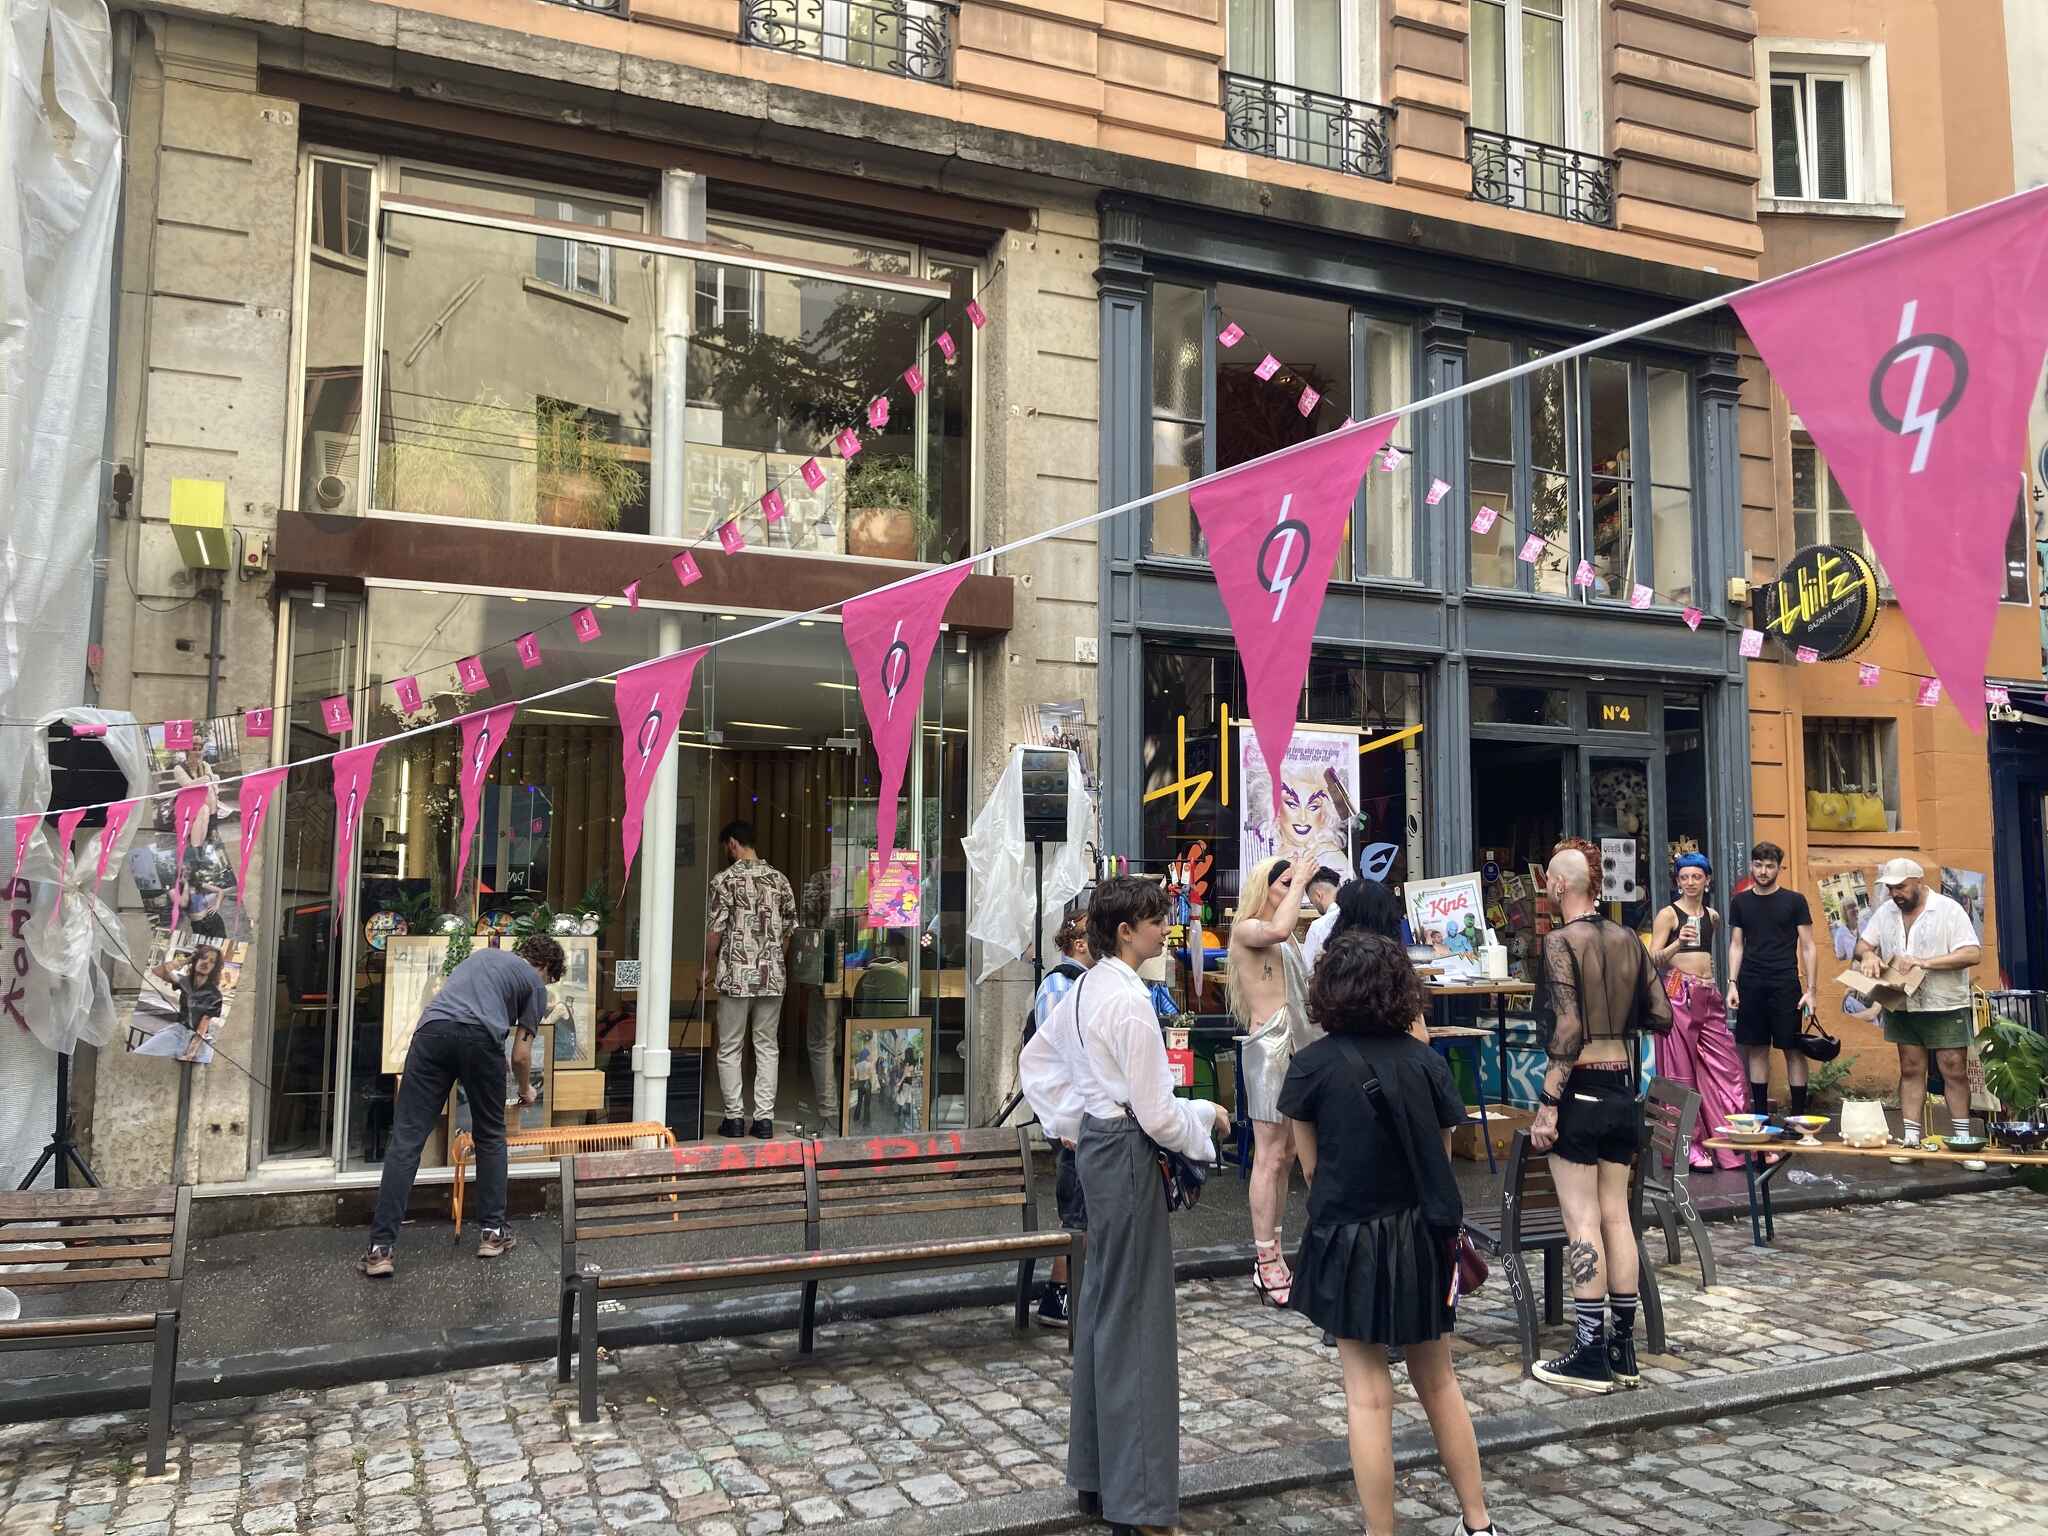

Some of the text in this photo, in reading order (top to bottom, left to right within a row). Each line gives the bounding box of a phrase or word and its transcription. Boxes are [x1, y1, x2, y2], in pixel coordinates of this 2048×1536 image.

[1807, 613, 1827, 632] BAZAR
[1832, 593, 1857, 615] GALERIE
[1603, 705, 1631, 721] N°4
[1429, 893, 1468, 917] Kink
